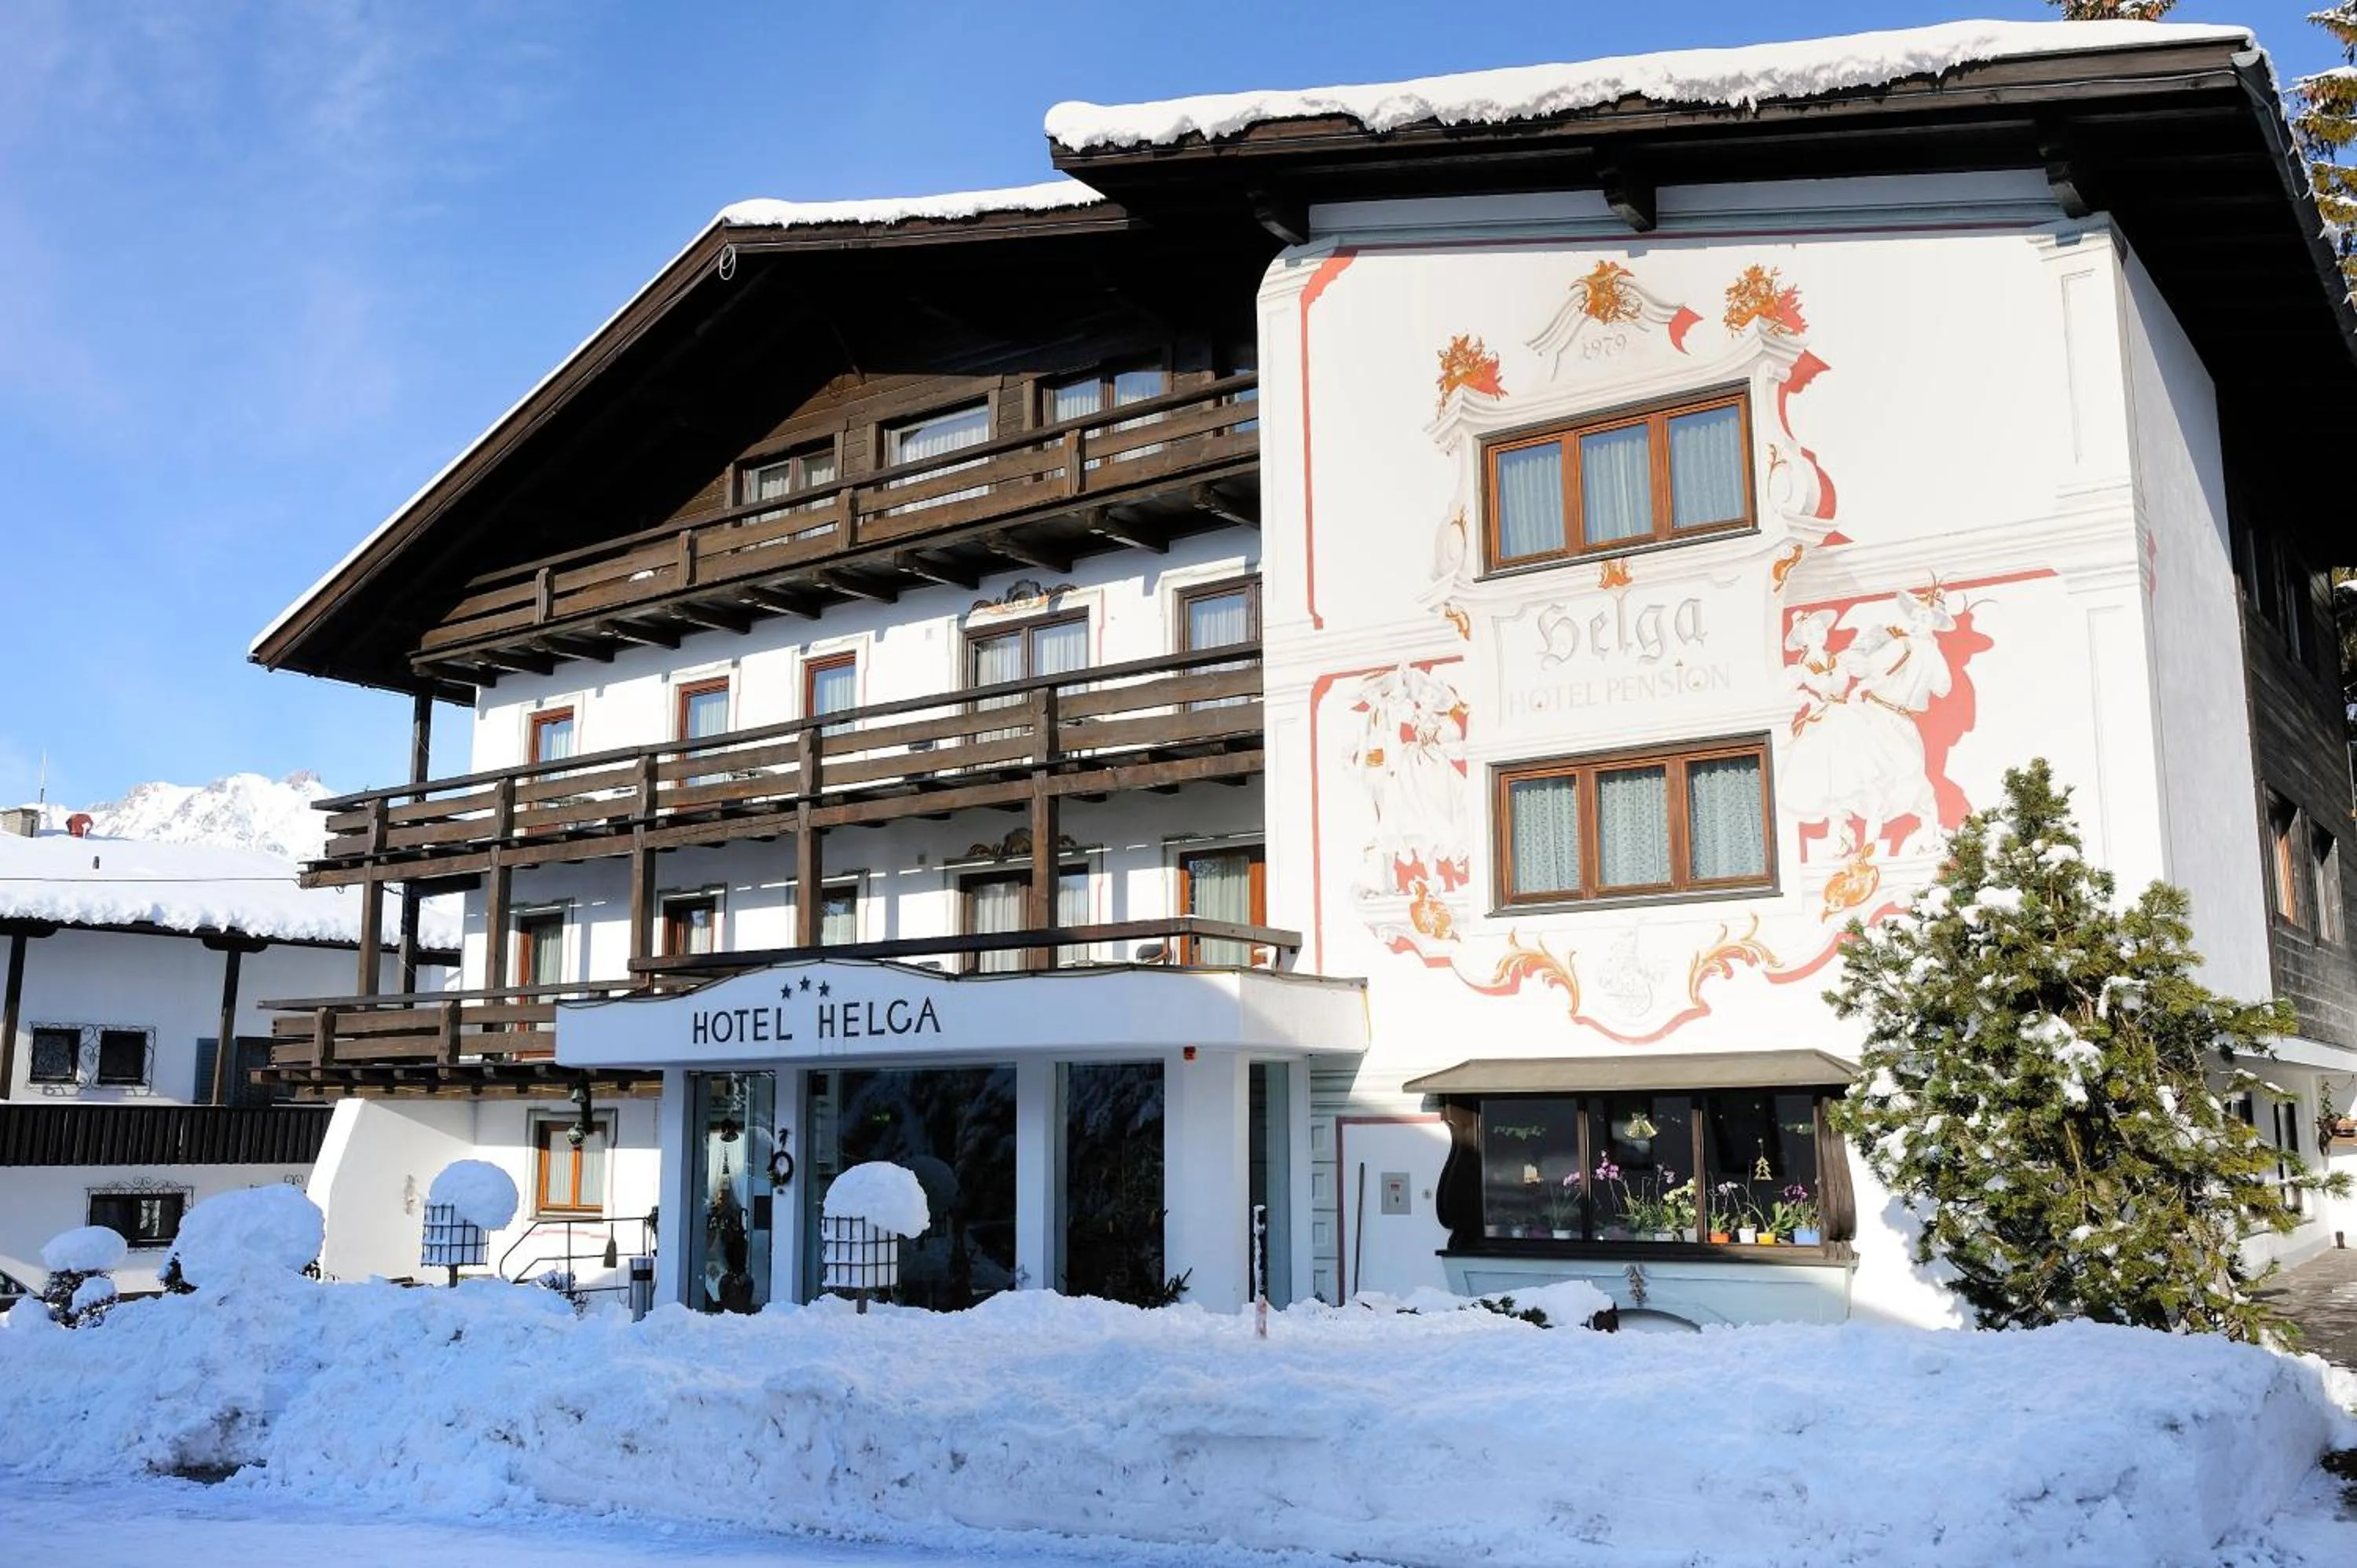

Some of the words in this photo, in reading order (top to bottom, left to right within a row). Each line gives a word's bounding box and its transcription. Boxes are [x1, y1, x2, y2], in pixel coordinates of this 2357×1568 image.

[1536, 597, 1709, 670] Helga
[1508, 681, 1597, 717] HOTEL
[1607, 661, 1731, 705] PENSION
[693, 1007, 793, 1044] HOTEL
[819, 996, 941, 1039] HELGA
